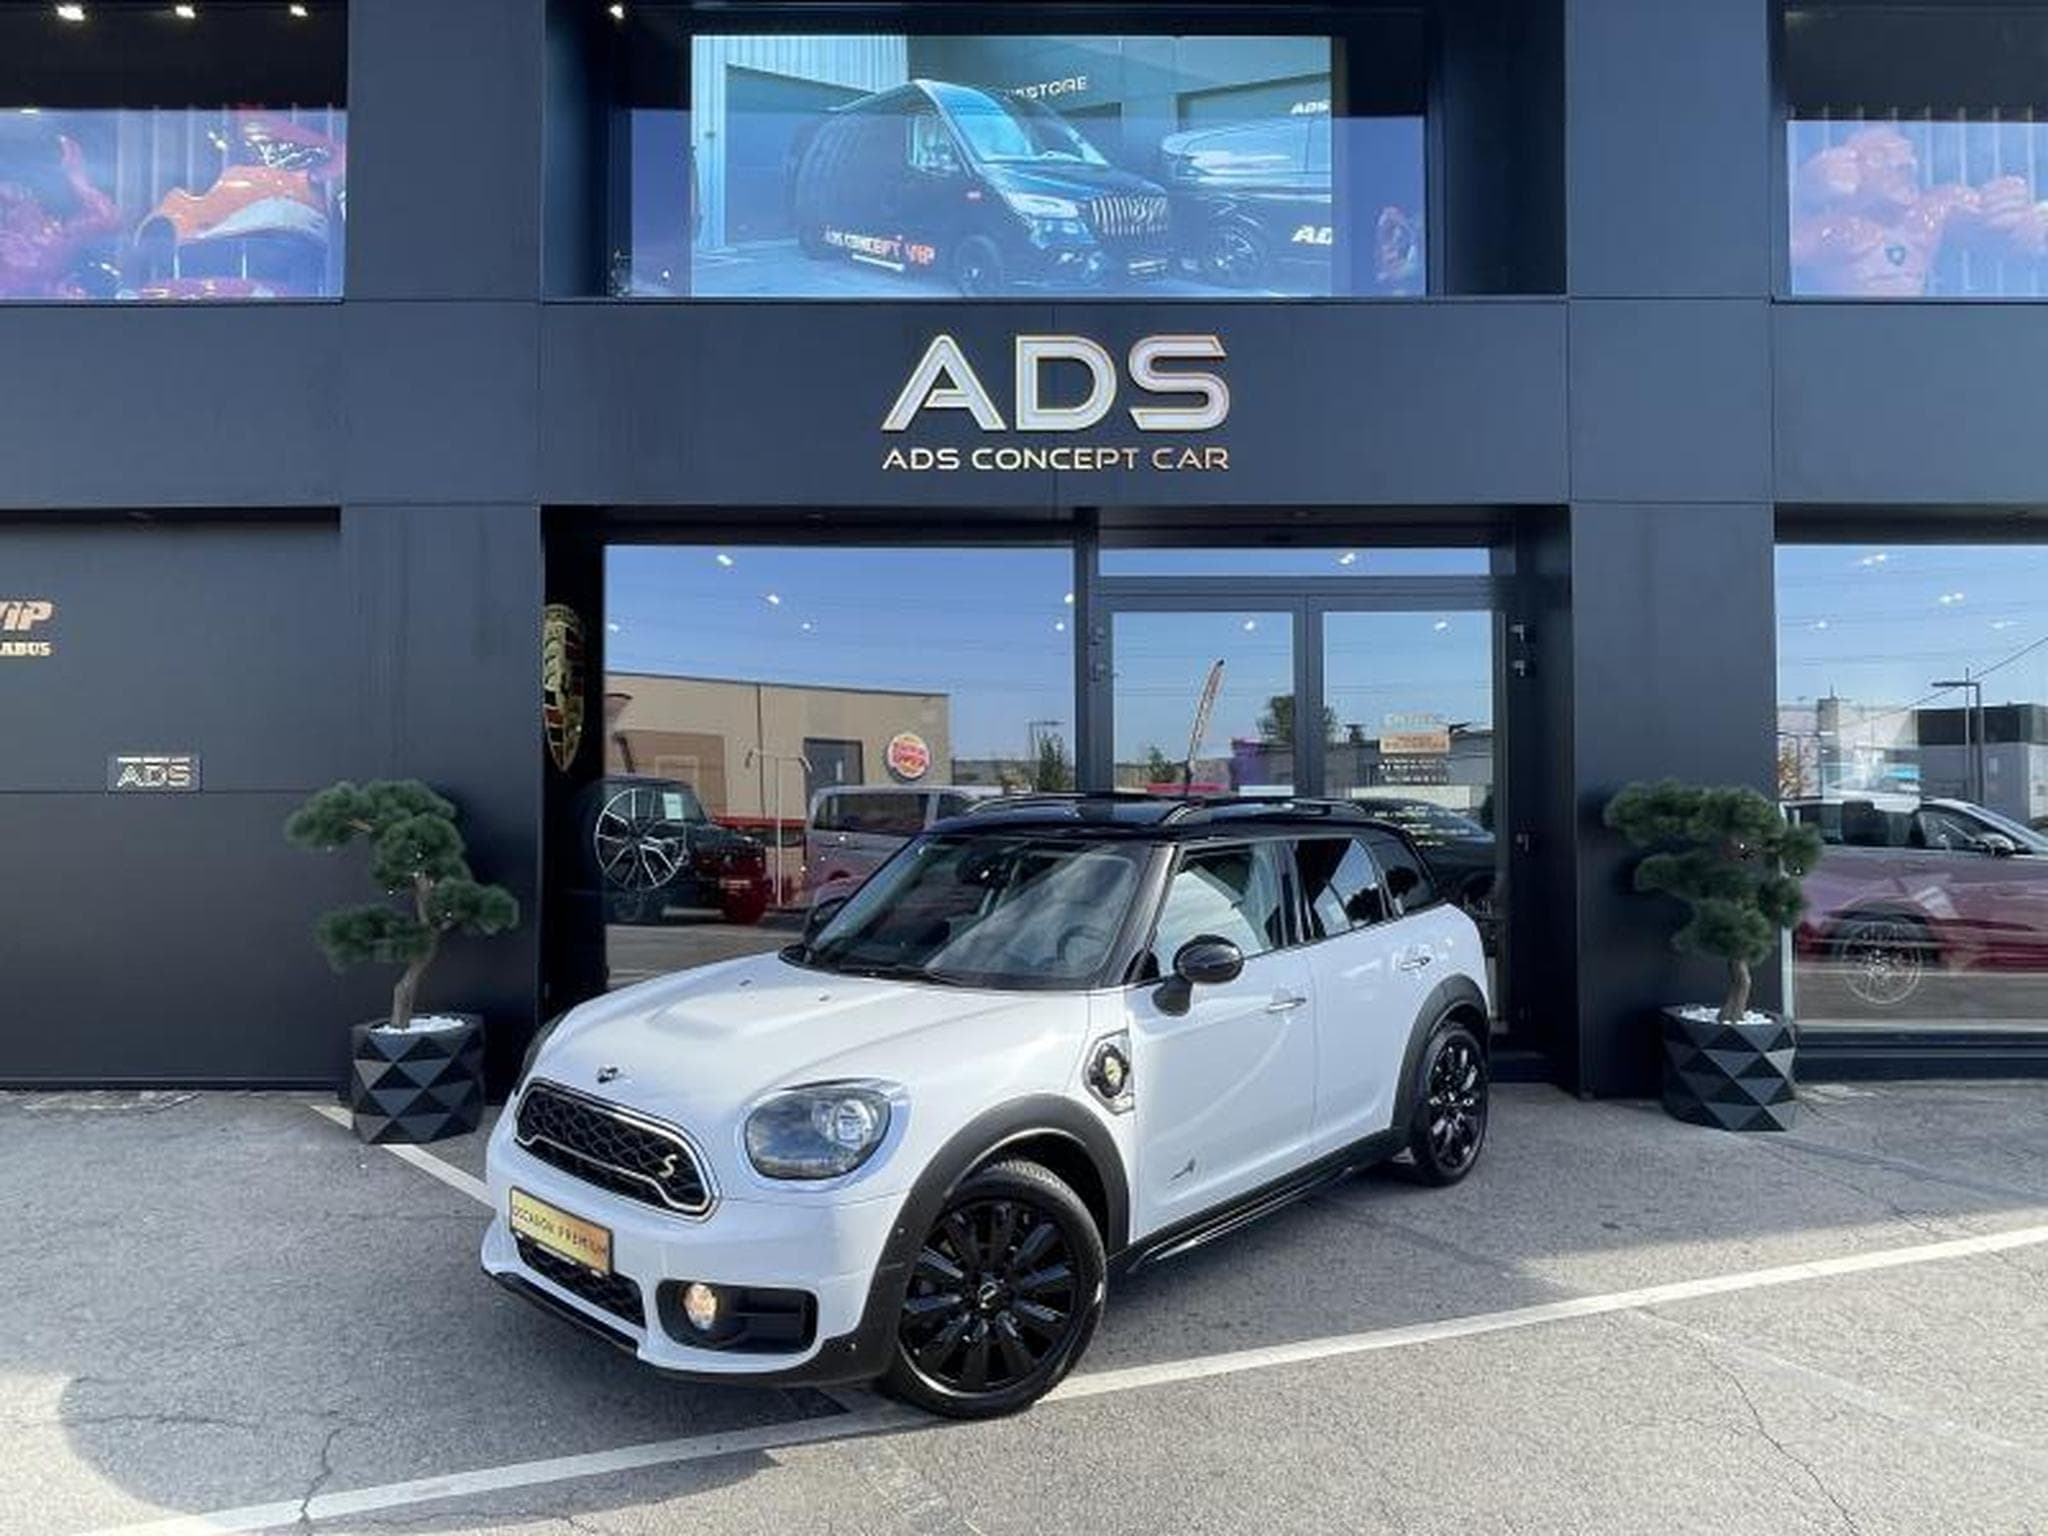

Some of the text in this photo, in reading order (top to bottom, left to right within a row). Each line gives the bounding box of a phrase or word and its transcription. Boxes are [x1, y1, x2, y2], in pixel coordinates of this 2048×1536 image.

[881, 334, 1231, 431] ADS
[882, 448, 1230, 470] ADS CONCEPT CAR
[117, 764, 191, 787] ADS
[659, 1153, 677, 1179] S
